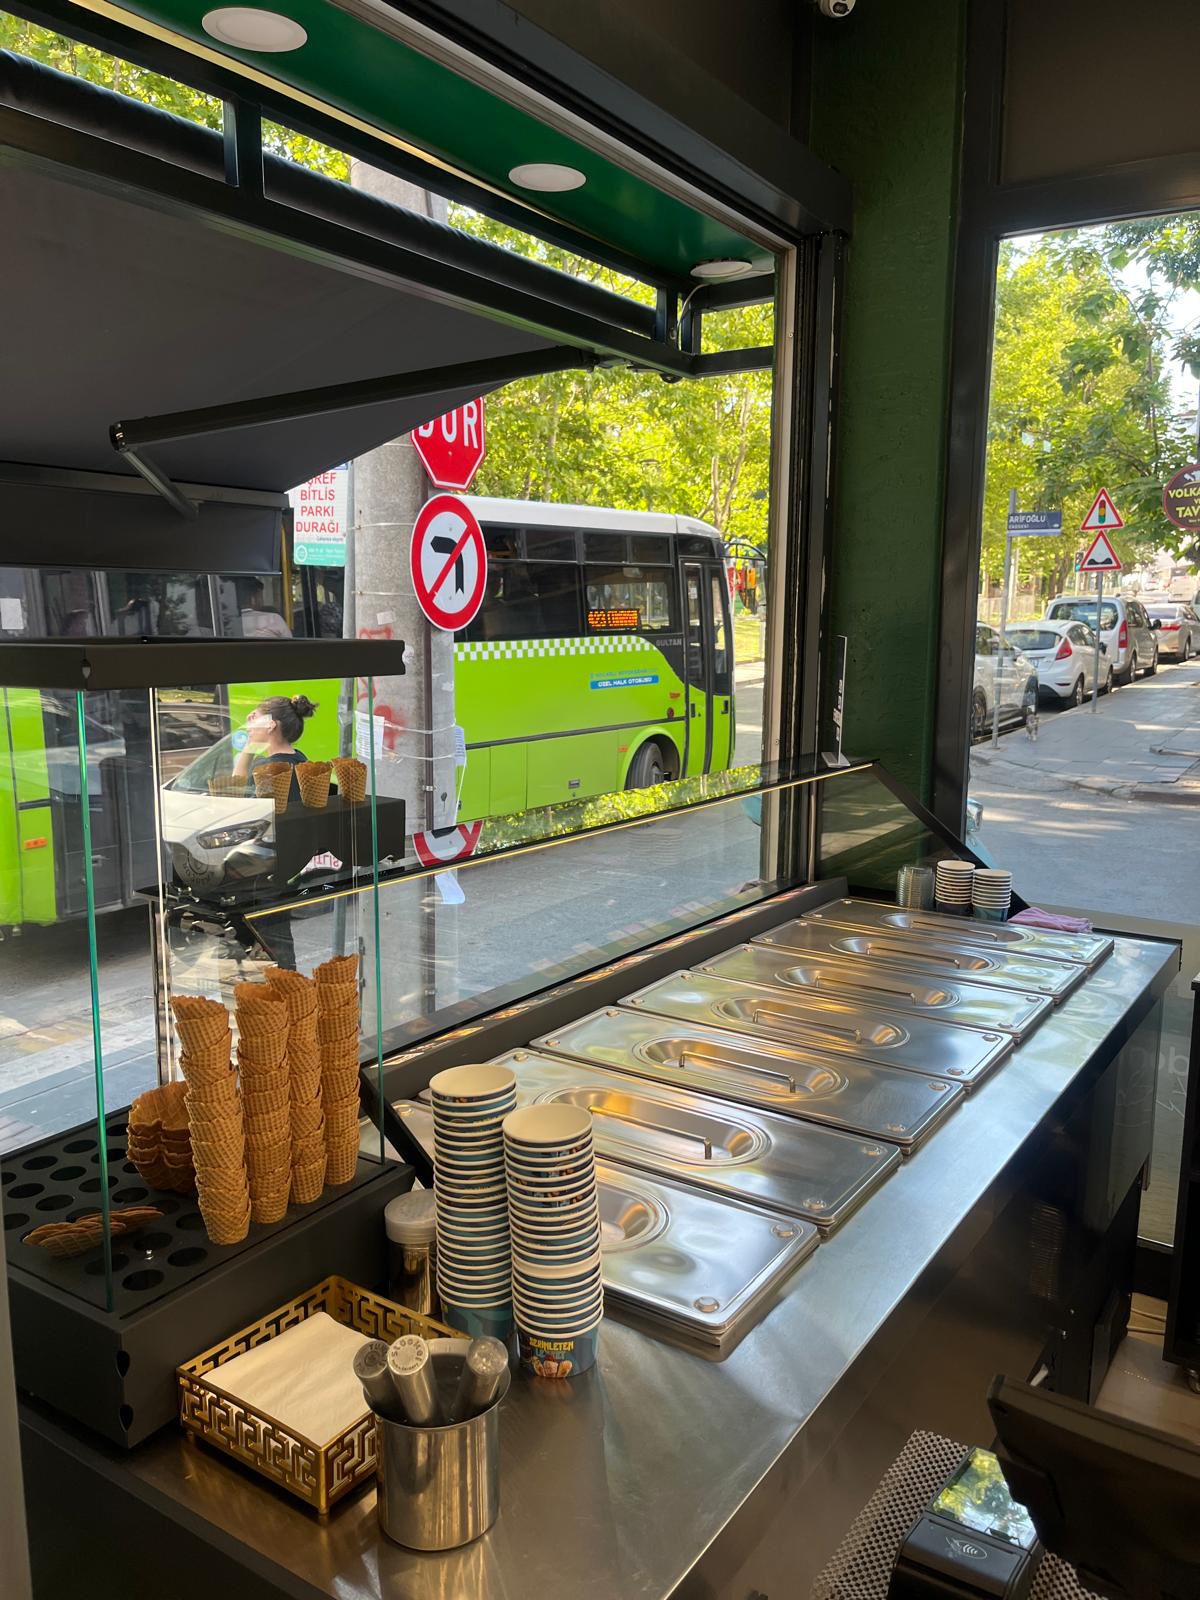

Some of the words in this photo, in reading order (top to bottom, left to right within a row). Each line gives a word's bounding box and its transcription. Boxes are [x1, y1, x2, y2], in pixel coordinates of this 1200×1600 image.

[300, 487, 336, 501] BİTLİS
[300, 505, 335, 517] PARKI
[295, 519, 339, 533] DURAĞI
